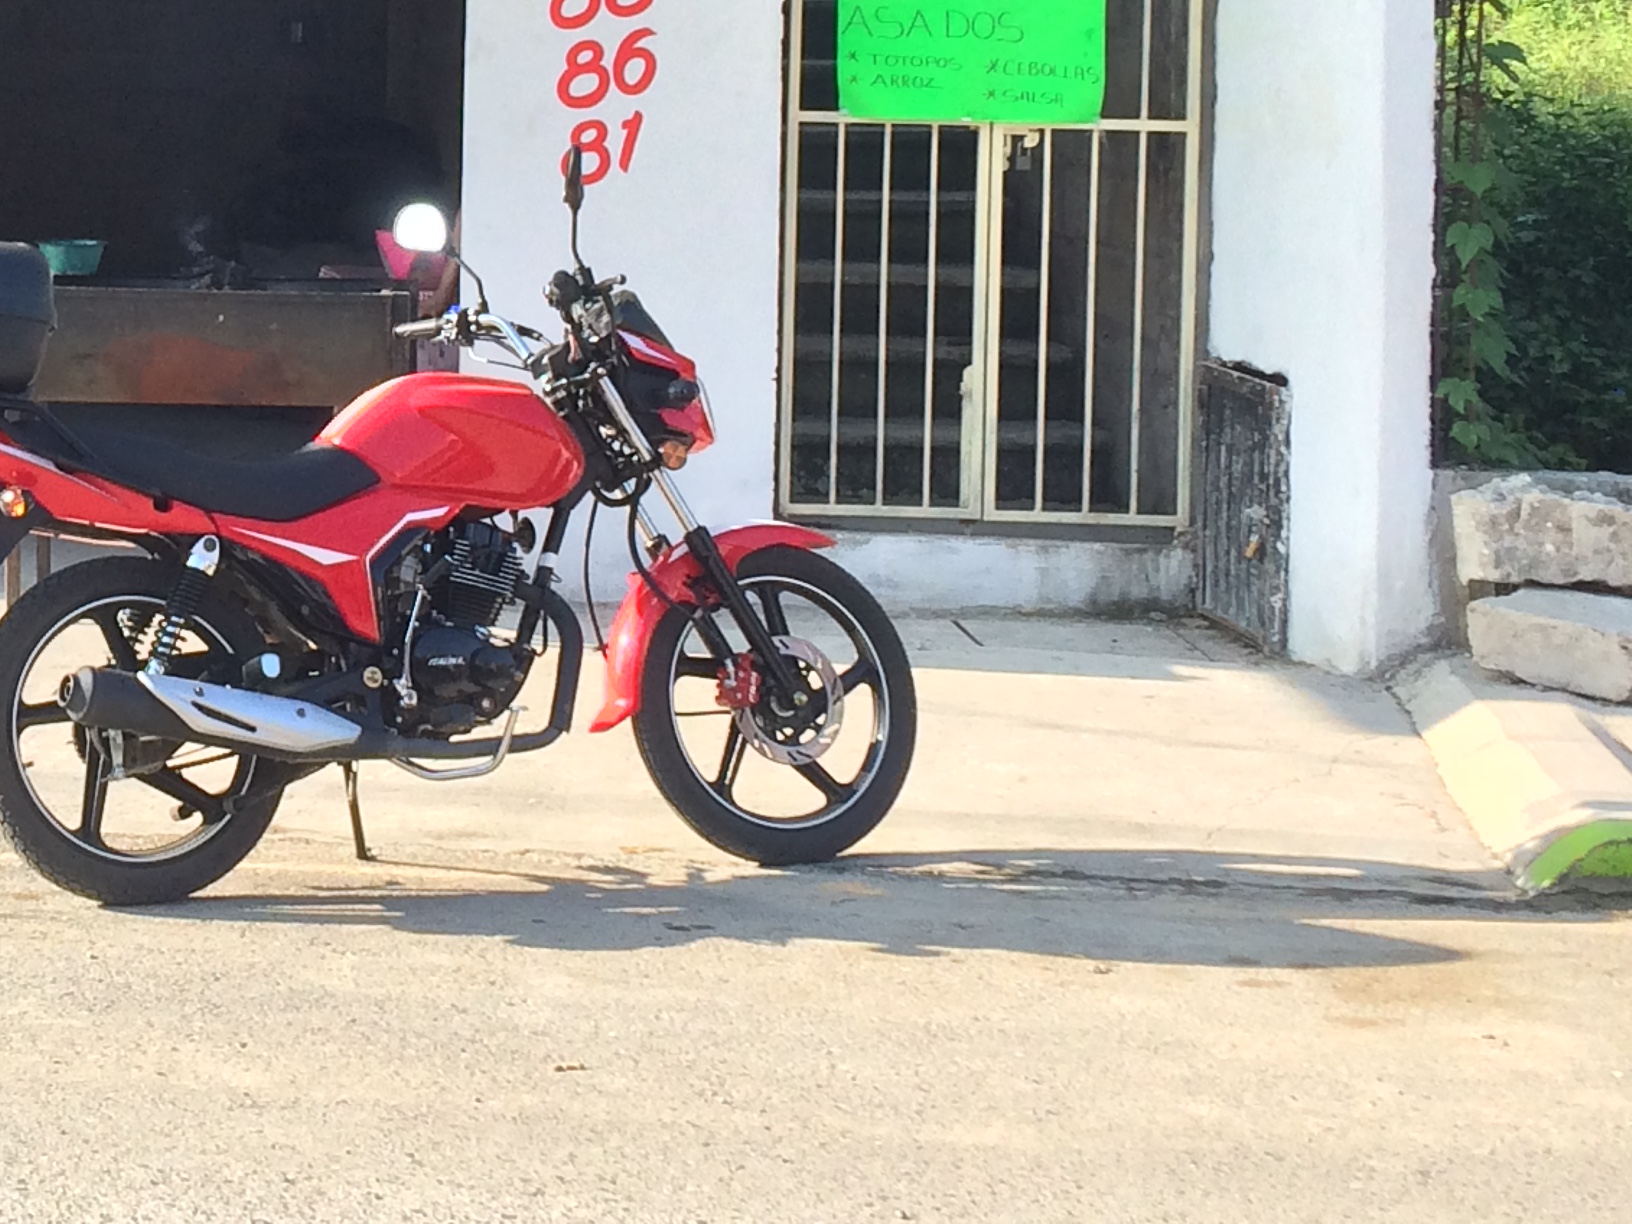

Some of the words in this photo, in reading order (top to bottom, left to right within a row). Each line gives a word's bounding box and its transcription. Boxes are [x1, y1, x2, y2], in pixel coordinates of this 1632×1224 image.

[841, 5, 1025, 44] ASADOS
[555, 26, 658, 109] 86
[870, 73, 944, 90] ARROZ
[1002, 90, 1065, 108] SALSA
[558, 109, 644, 186] 81
